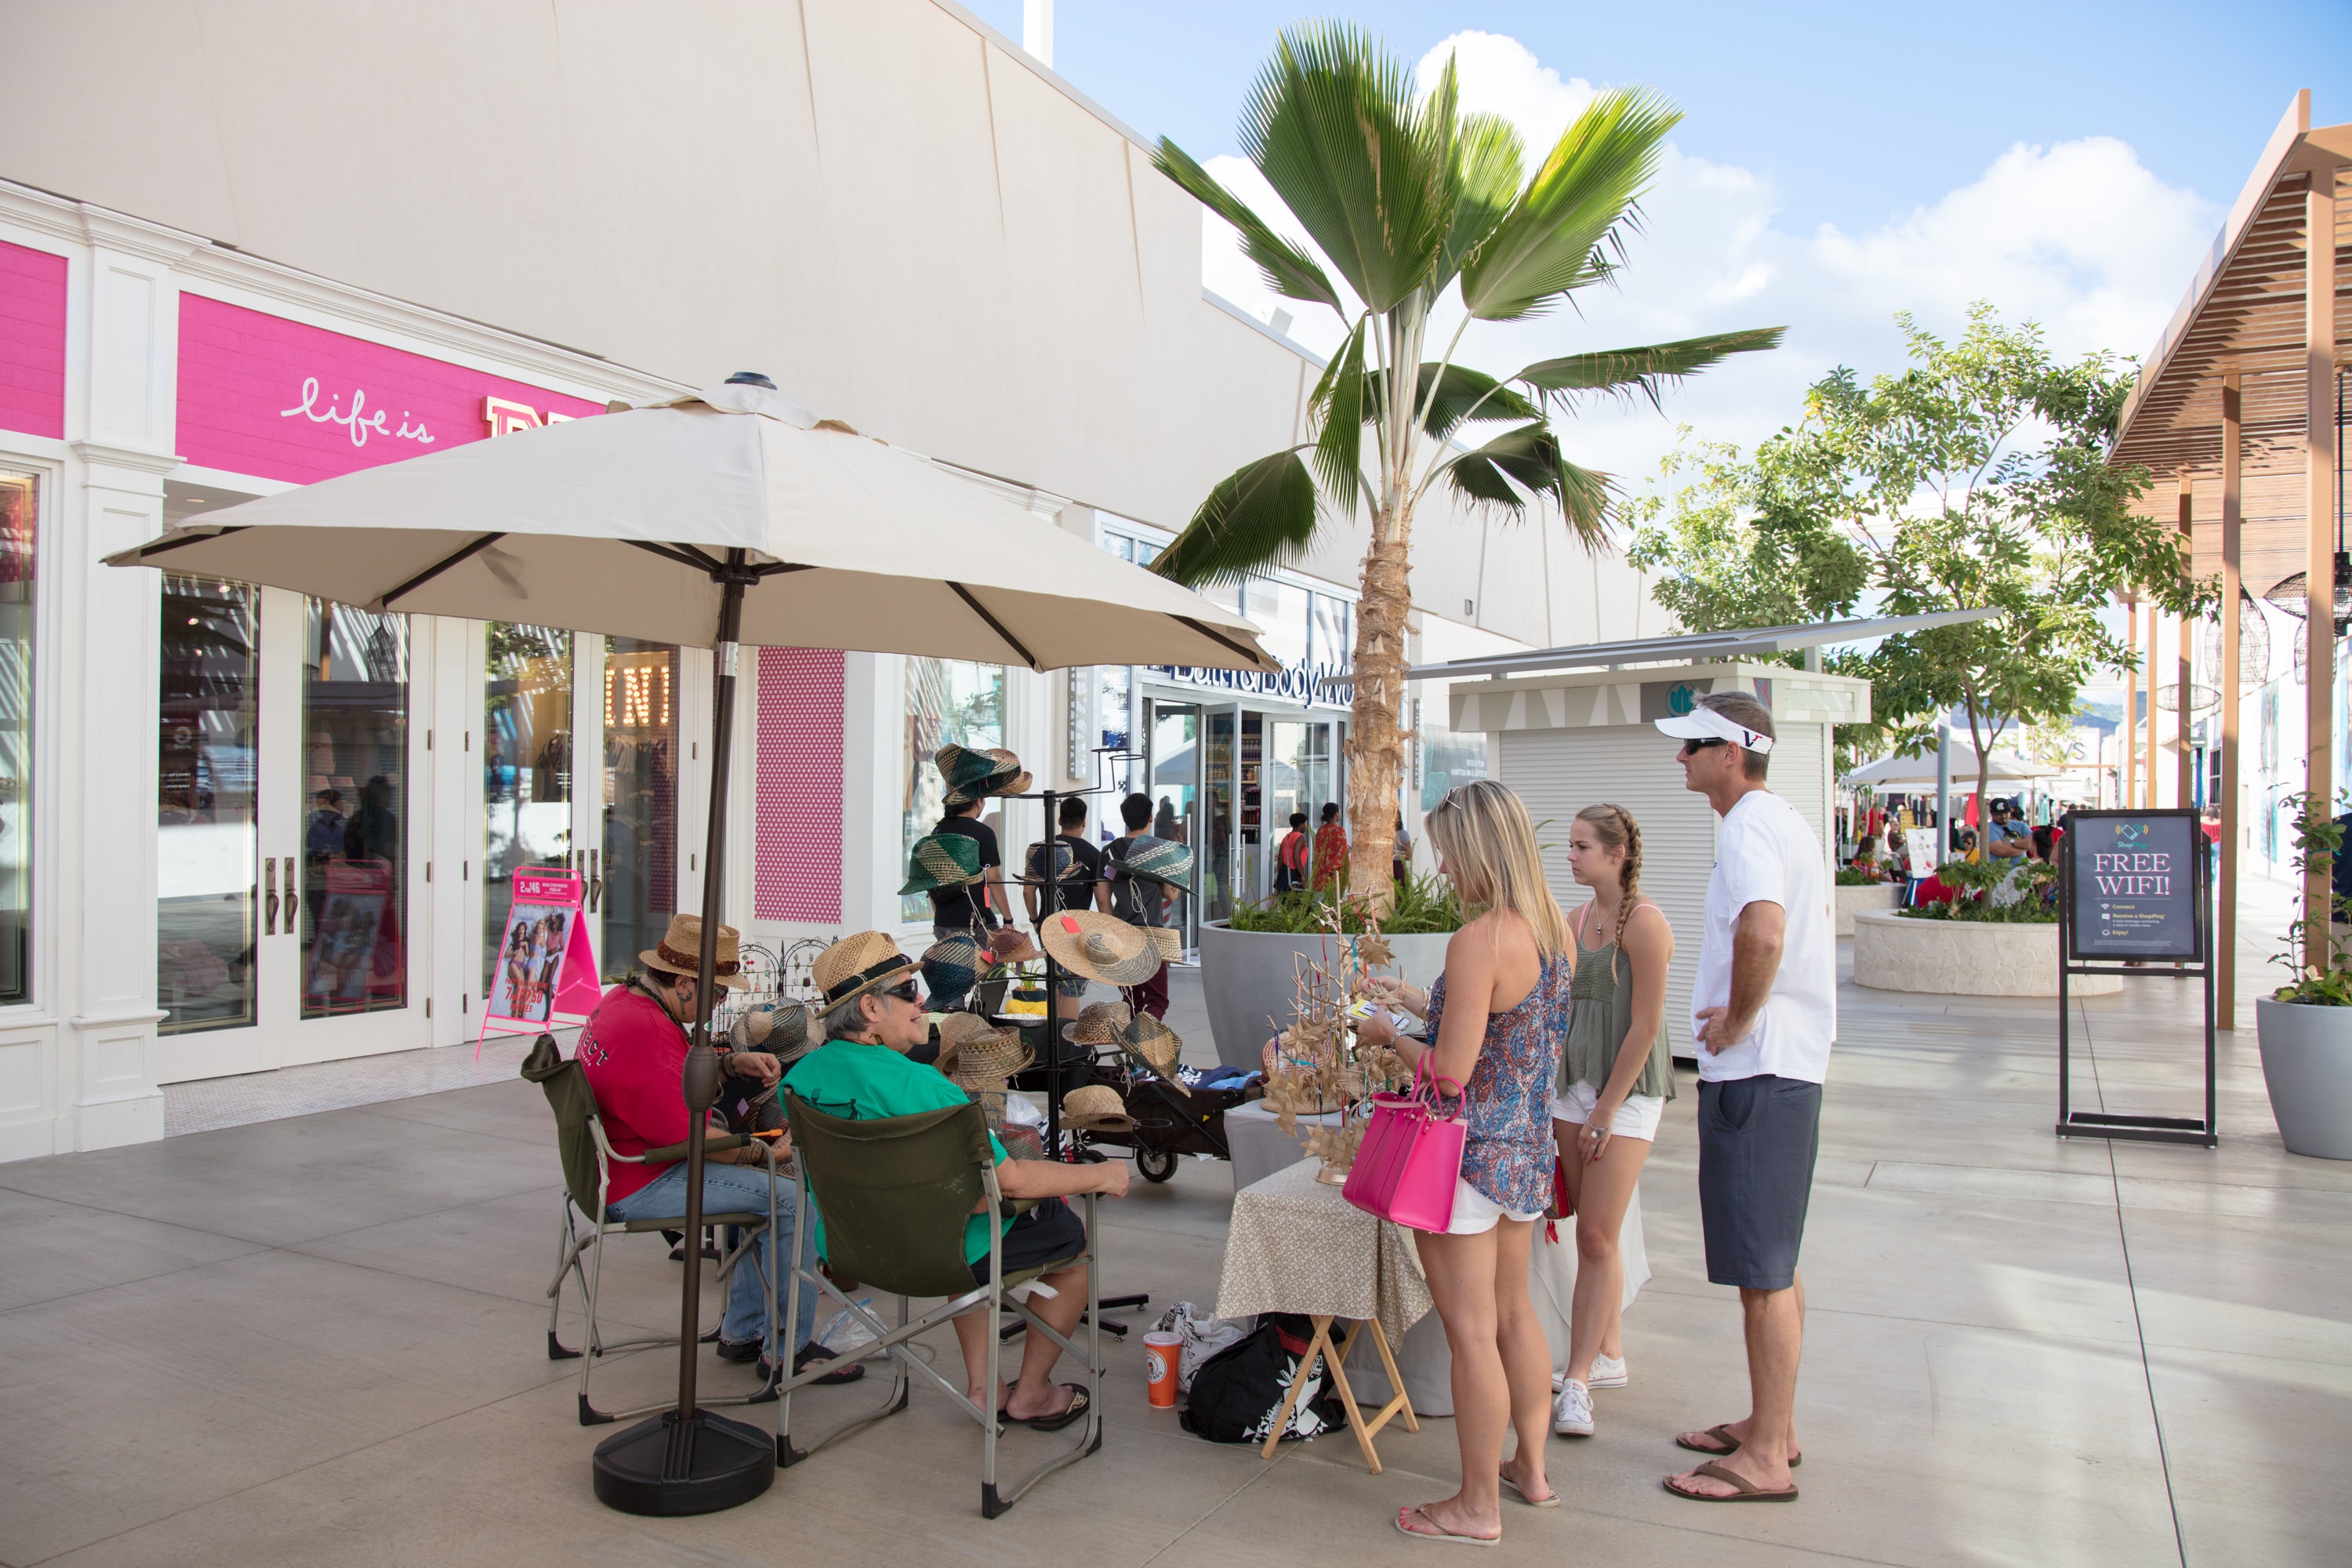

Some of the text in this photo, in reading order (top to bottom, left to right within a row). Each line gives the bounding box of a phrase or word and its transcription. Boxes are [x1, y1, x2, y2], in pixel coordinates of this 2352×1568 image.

[281, 376, 390, 448] life
[395, 411, 435, 444] is
[2094, 853, 2171, 873] FREE
[2095, 876, 2170, 895] WIFI!
